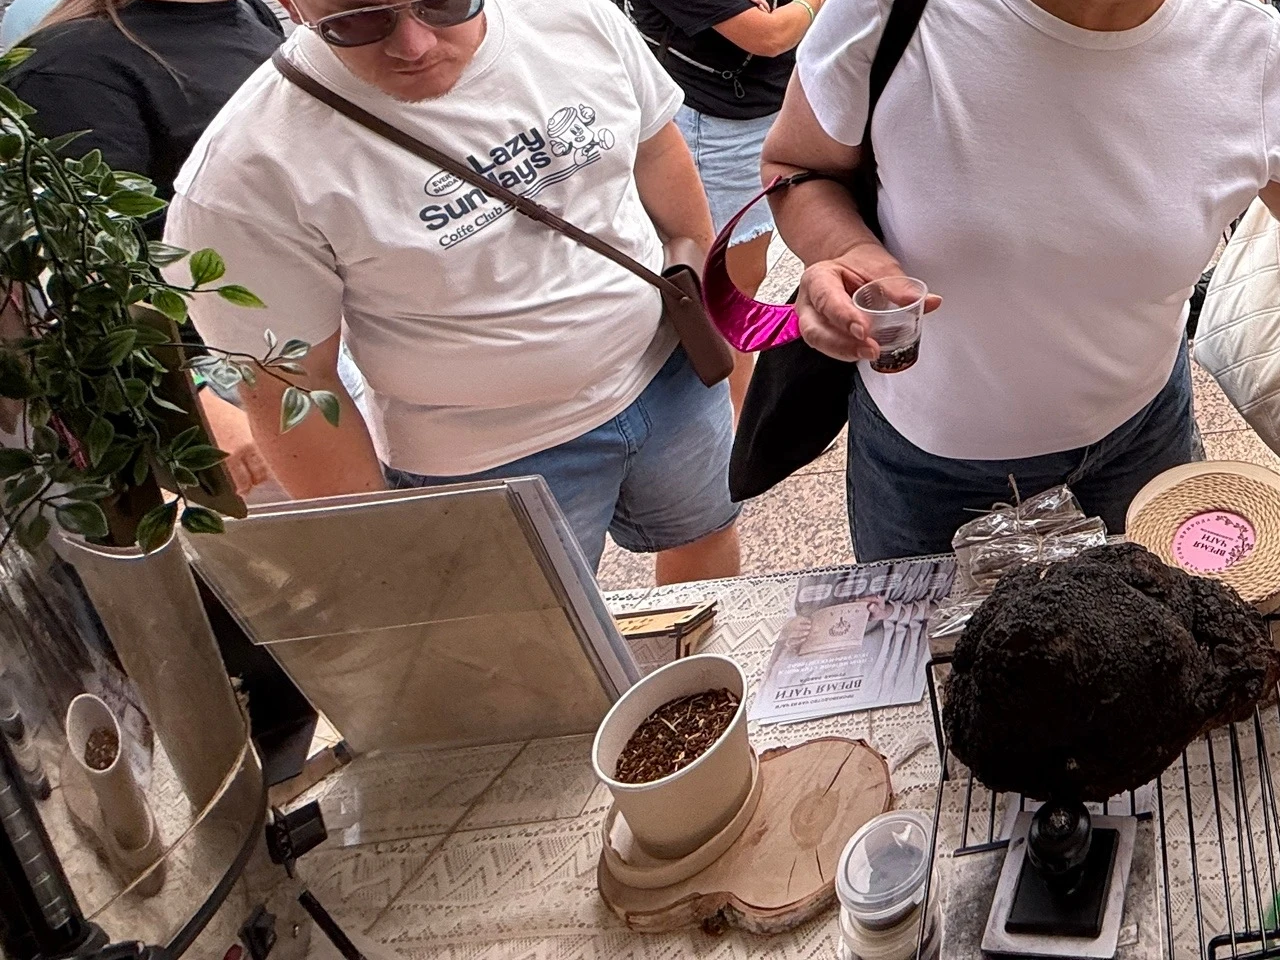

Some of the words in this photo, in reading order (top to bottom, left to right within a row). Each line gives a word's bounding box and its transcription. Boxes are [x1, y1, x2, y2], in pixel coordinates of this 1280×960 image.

[466, 127, 546, 175] Lazy
[432, 172, 457, 188] EVER
[433, 177, 460, 194] SUNDA
[439, 224, 475, 247] Coffe
[474, 206, 503, 227] Club
[1192, 540, 1227, 557] ВРЕМЯ
[1201, 533, 1228, 548] ЧАГИ
[774, 687, 812, 700] ЧАГИ
[815, 679, 863, 695] ВРЕМЯ
